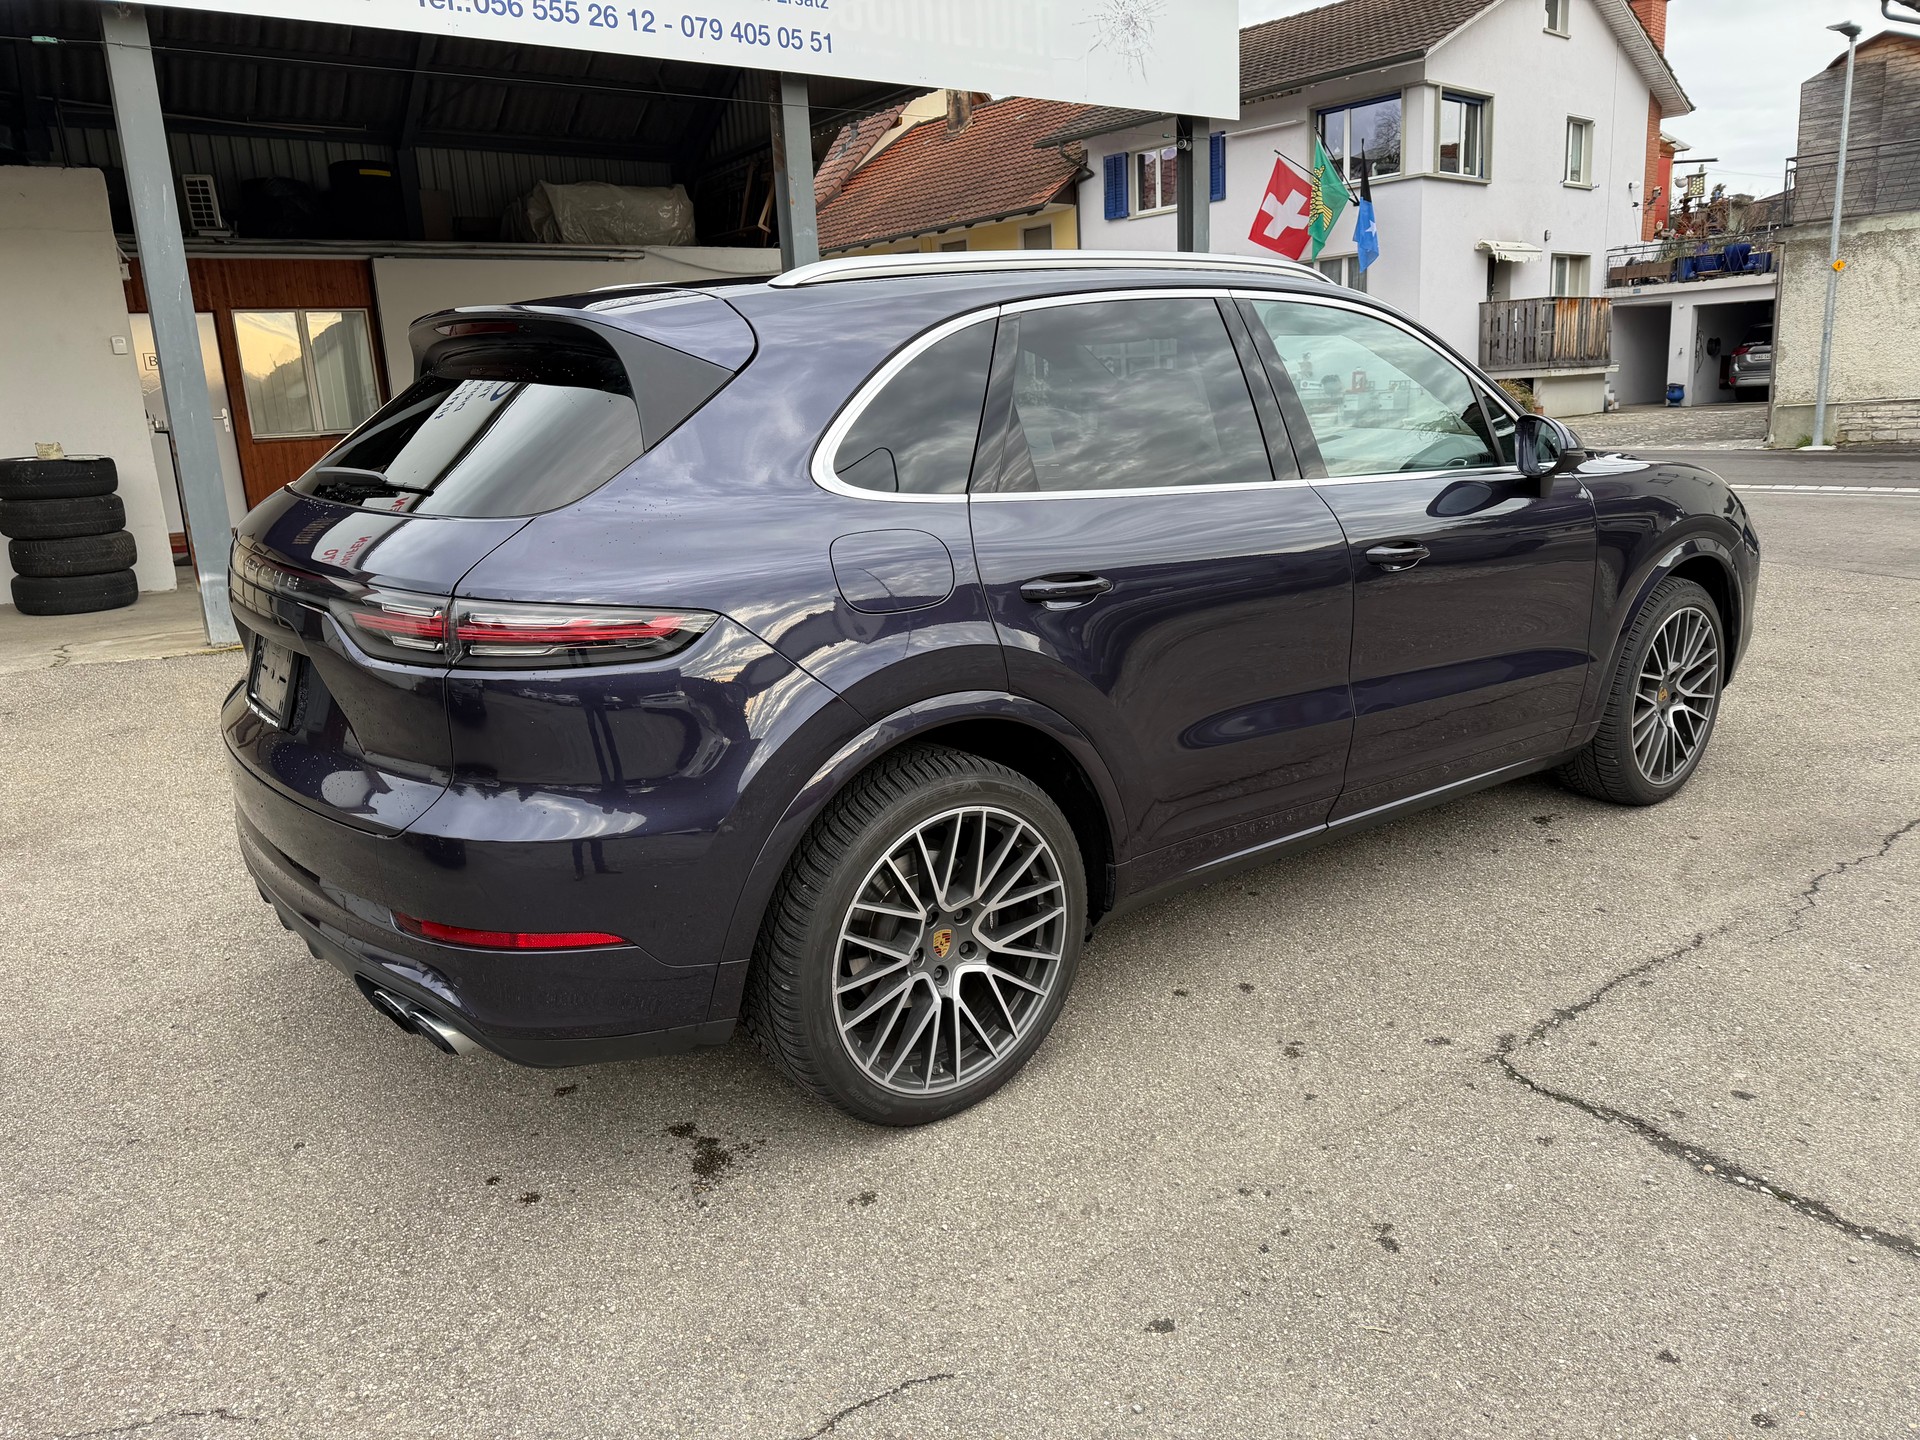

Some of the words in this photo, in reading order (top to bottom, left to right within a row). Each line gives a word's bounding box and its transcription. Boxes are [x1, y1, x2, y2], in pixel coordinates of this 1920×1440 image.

[776, 0, 829, 10] satz
[532, 0, 580, 25] 555
[587, 3, 619, 29] 26
[627, 8, 656, 33] 12
[680, 15, 723, 41] 079
[730, 21, 771, 46] 405
[777, 26, 803, 50] 05
[810, 30, 833, 53] 51
